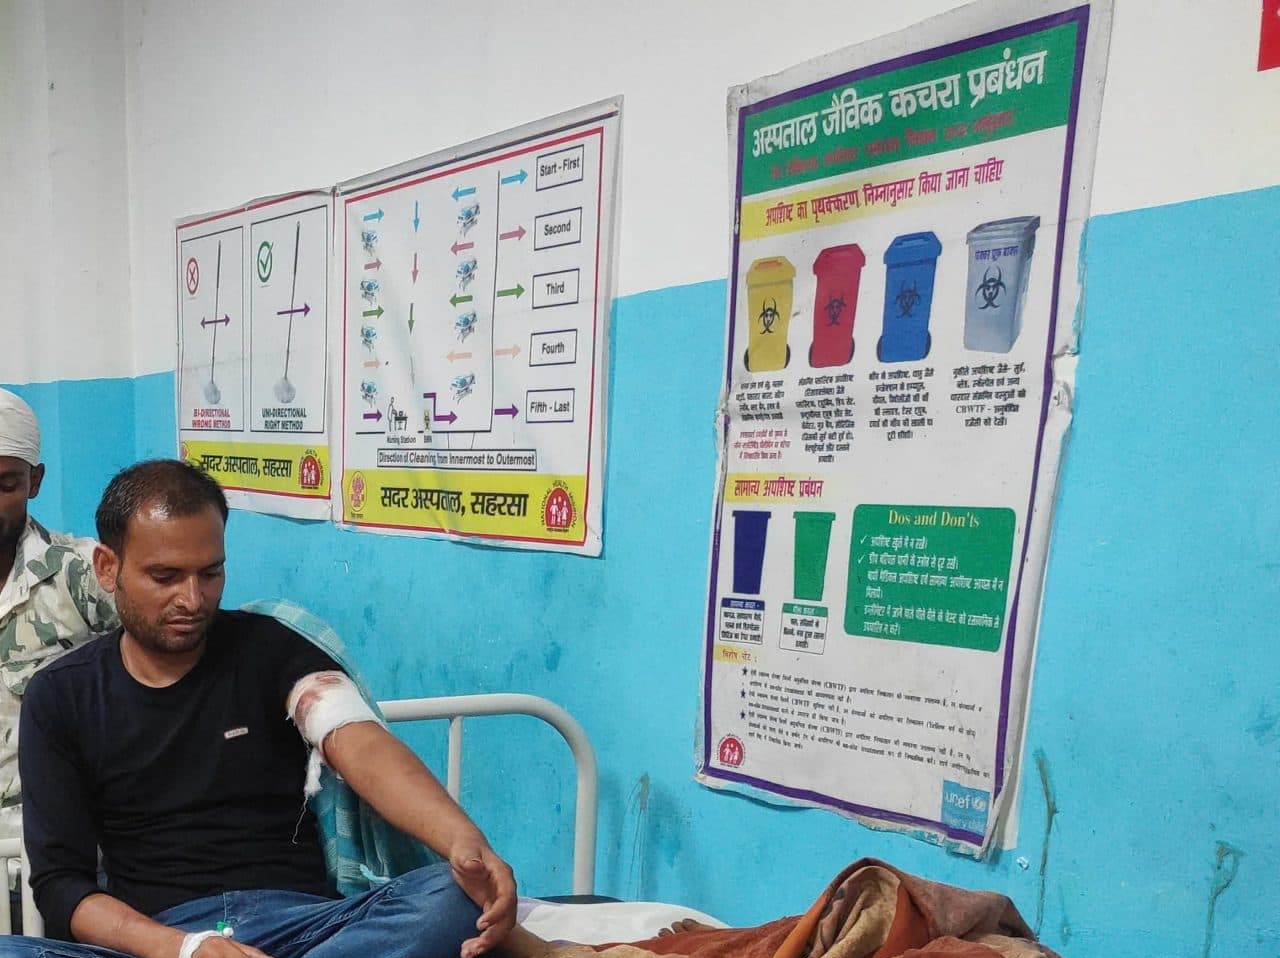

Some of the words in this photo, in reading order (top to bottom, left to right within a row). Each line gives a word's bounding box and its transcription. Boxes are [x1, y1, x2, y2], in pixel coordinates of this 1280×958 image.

[752, 112, 818, 157] अस्पताल
[822, 88, 883, 136] जैविक
[889, 73, 960, 117] कचरा
[967, 48, 1047, 107] प्रबंधन
[540, 163, 556, 176] Start
[563, 157, 580, 171] First
[919, 172, 942, 196] किया
[946, 167, 970, 190] जाना
[974, 157, 1004, 185] चाहिए
[544, 220, 571, 236] Second
[546, 282, 565, 295] Third
[542, 342, 564, 354] Fourth
[262, 408, 307, 418] UNI-DIRECTIONAL
[530, 402, 547, 413] Fifth
[554, 400, 570, 412] Last
[201, 455, 223, 471] सदर
[223, 456, 260, 477] अस्पताल,
[262, 459, 293, 477] सहरसा
[379, 452, 403, 463] Direction
[409, 453, 436, 466] Cleaning
[437, 454, 448, 464] from
[450, 454, 486, 464] Innermost
[487, 455, 494, 465] to
[496, 453, 534, 466] Outermost
[380, 487, 410, 509] सदर
[411, 489, 465, 517] अस्पताल,
[470, 492, 529, 517] सहरसा
[888, 510, 910, 524] Dos
[914, 512, 937, 526] and
[940, 511, 979, 527] Don'ts
